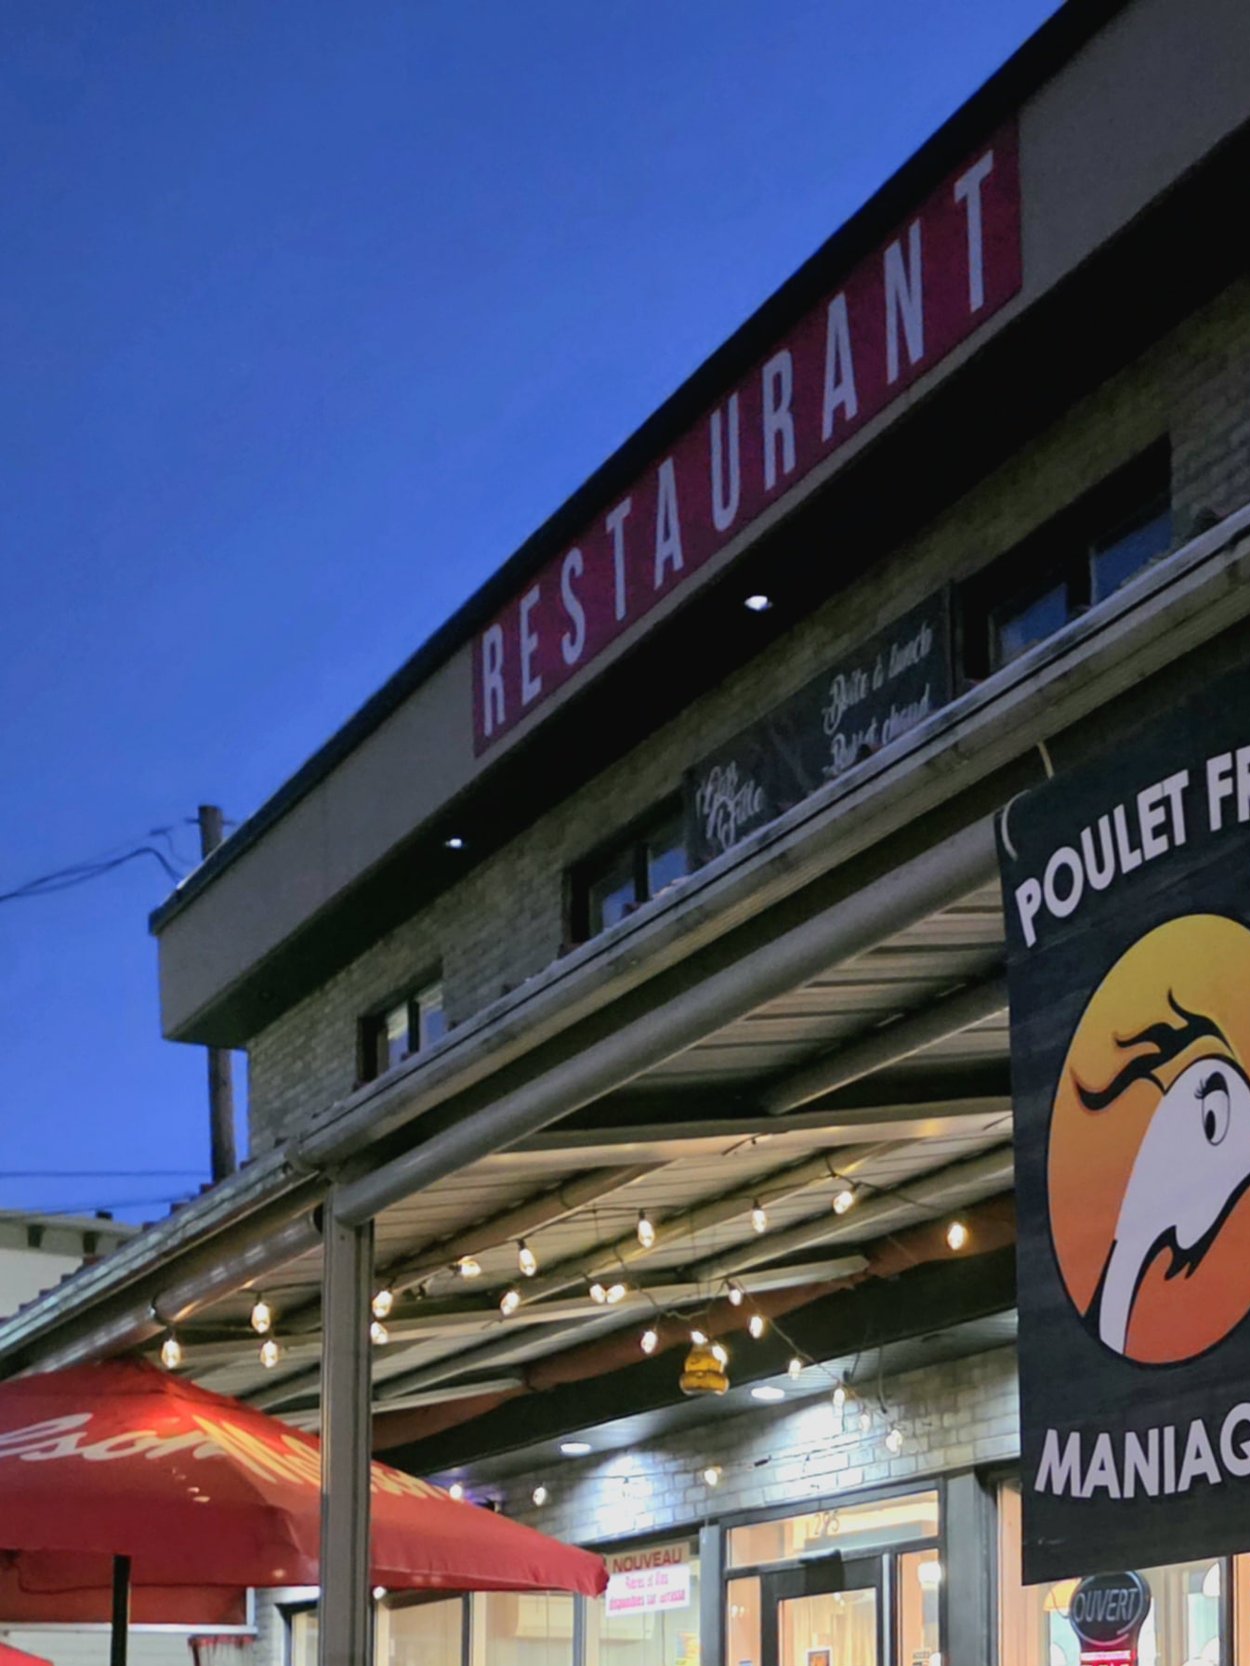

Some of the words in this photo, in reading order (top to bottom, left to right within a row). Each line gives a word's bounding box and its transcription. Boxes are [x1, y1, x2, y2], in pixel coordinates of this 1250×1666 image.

[482, 149, 993, 736] RESTAURANT
[1014, 769, 1189, 948] POULET
[612, 1547, 683, 1573] NOUVEAU
[1072, 1588, 1138, 1623] OUVERT
